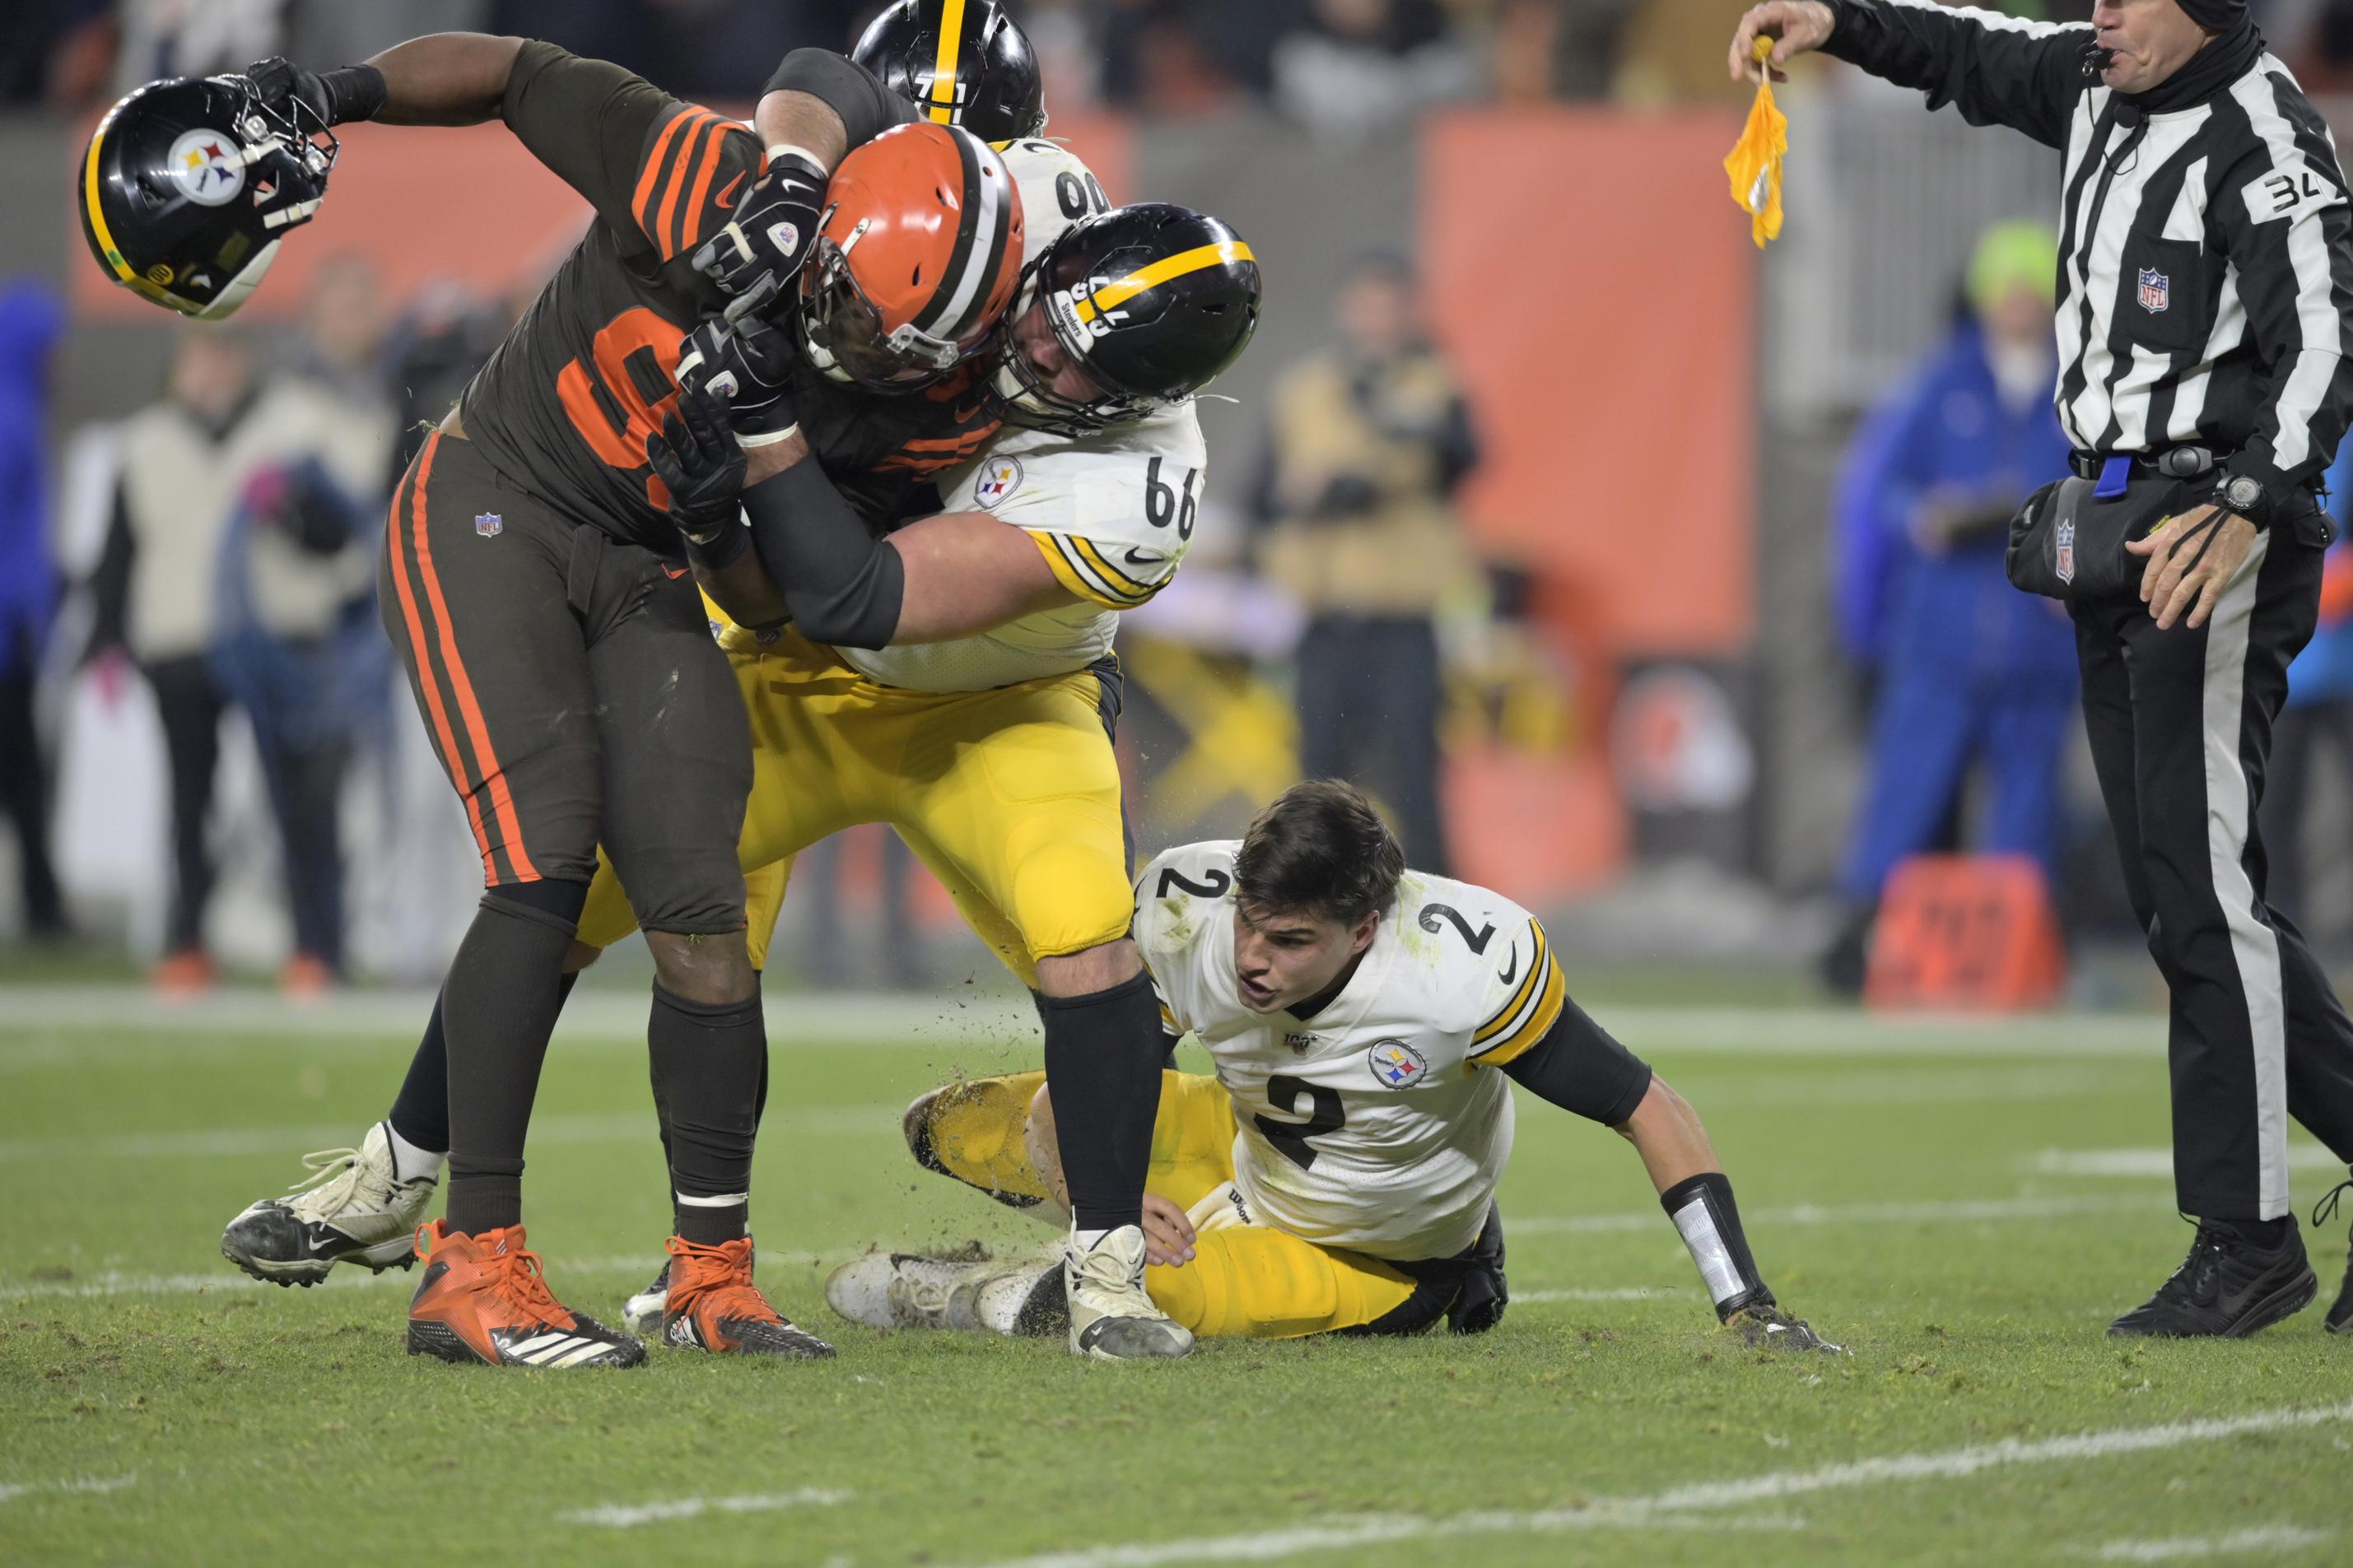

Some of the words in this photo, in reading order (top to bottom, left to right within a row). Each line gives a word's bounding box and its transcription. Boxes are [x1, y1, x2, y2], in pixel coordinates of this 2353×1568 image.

[2141, 285, 2165, 307] NFL
[1060, 303, 1083, 338] Steelers
[1145, 456, 1198, 542] 66
[480, 523, 500, 533] NFL
[1155, 868, 1231, 899] 2
[1418, 903, 1497, 956] 2
[1374, 1056, 1395, 1068] Steelers
[1253, 1074, 1346, 1172] 2
